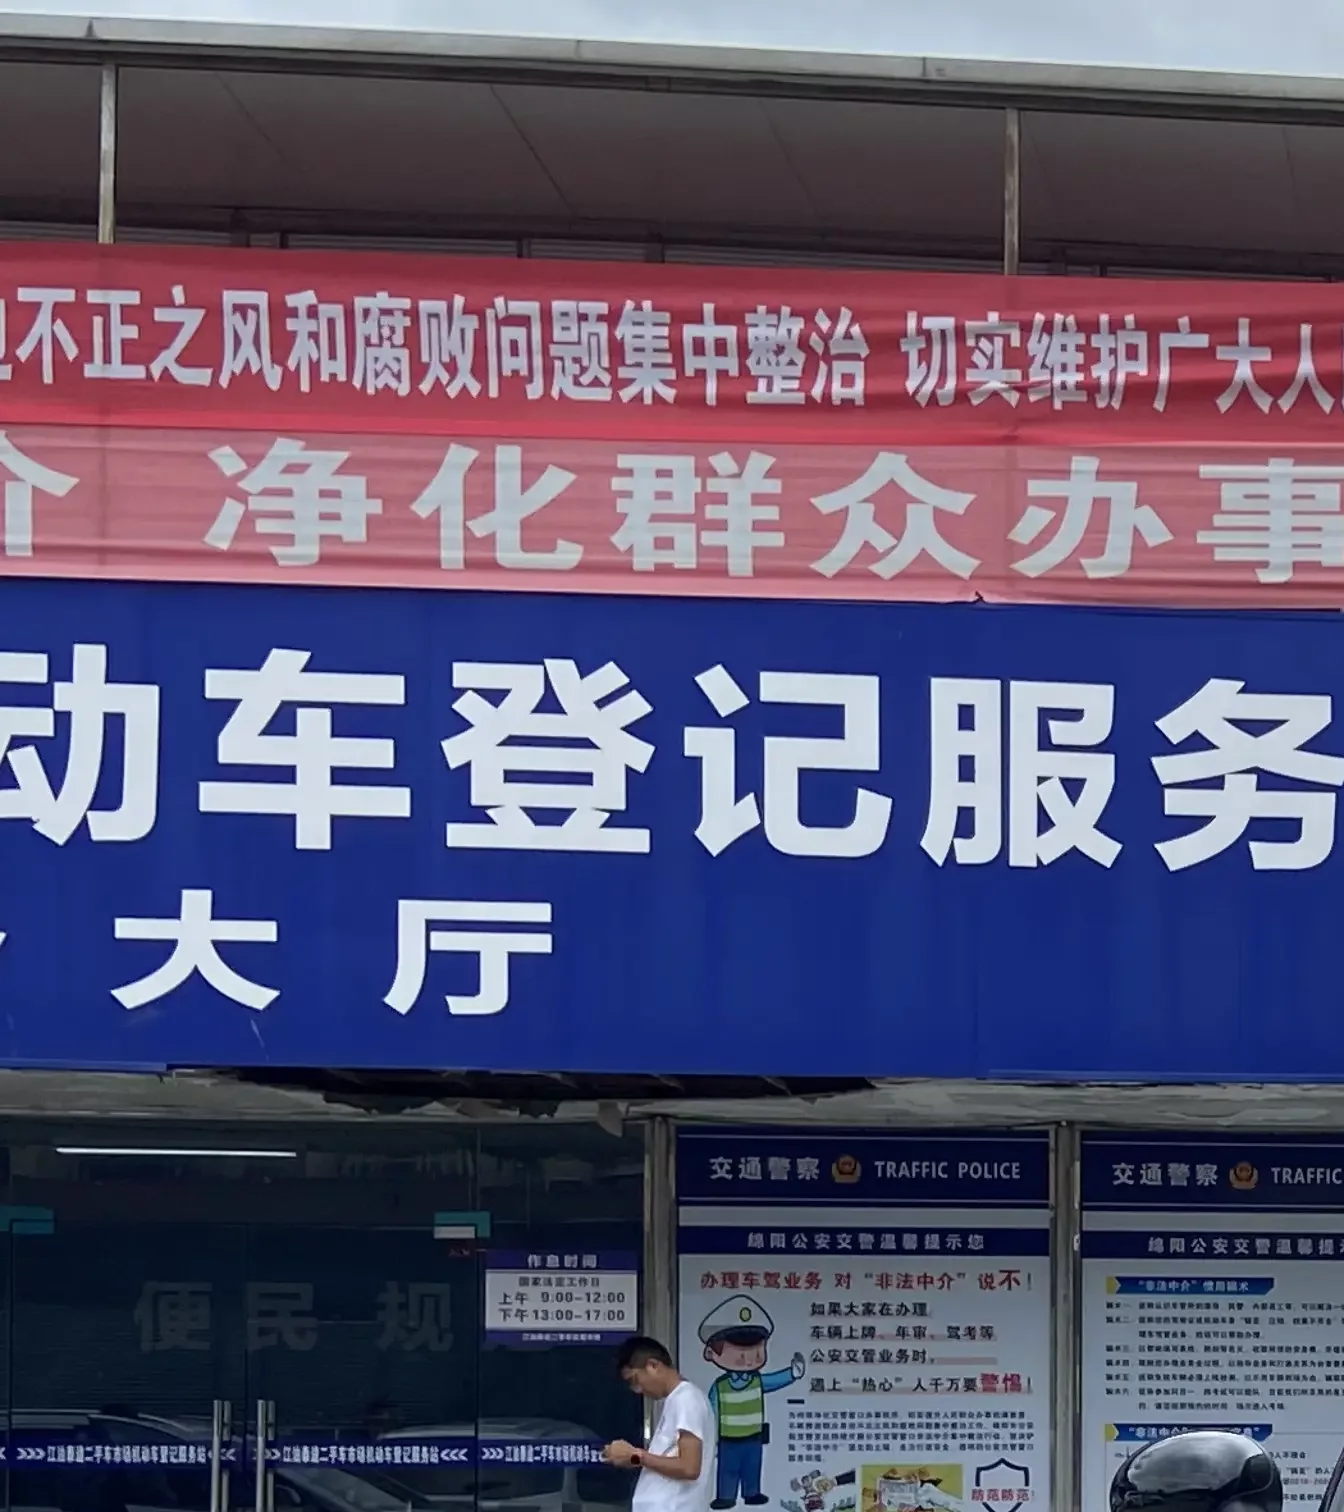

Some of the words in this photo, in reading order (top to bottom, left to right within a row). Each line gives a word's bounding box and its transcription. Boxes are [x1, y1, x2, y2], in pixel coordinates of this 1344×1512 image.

[0, 284, 870, 407] 不正之风和腐败问题集中整治
[0, 888, 555, 1017] 大厅
[709, 1156, 820, 1181] 交通警察
[874, 1160, 949, 1180] TRAFFIC
[957, 1161, 1022, 1180] POLICE
[1111, 1162, 1219, 1187] 交通警察
[1270, 1166, 1343, 1185] TRAFFIC
[527, 1253, 598, 1269] 作息时间
